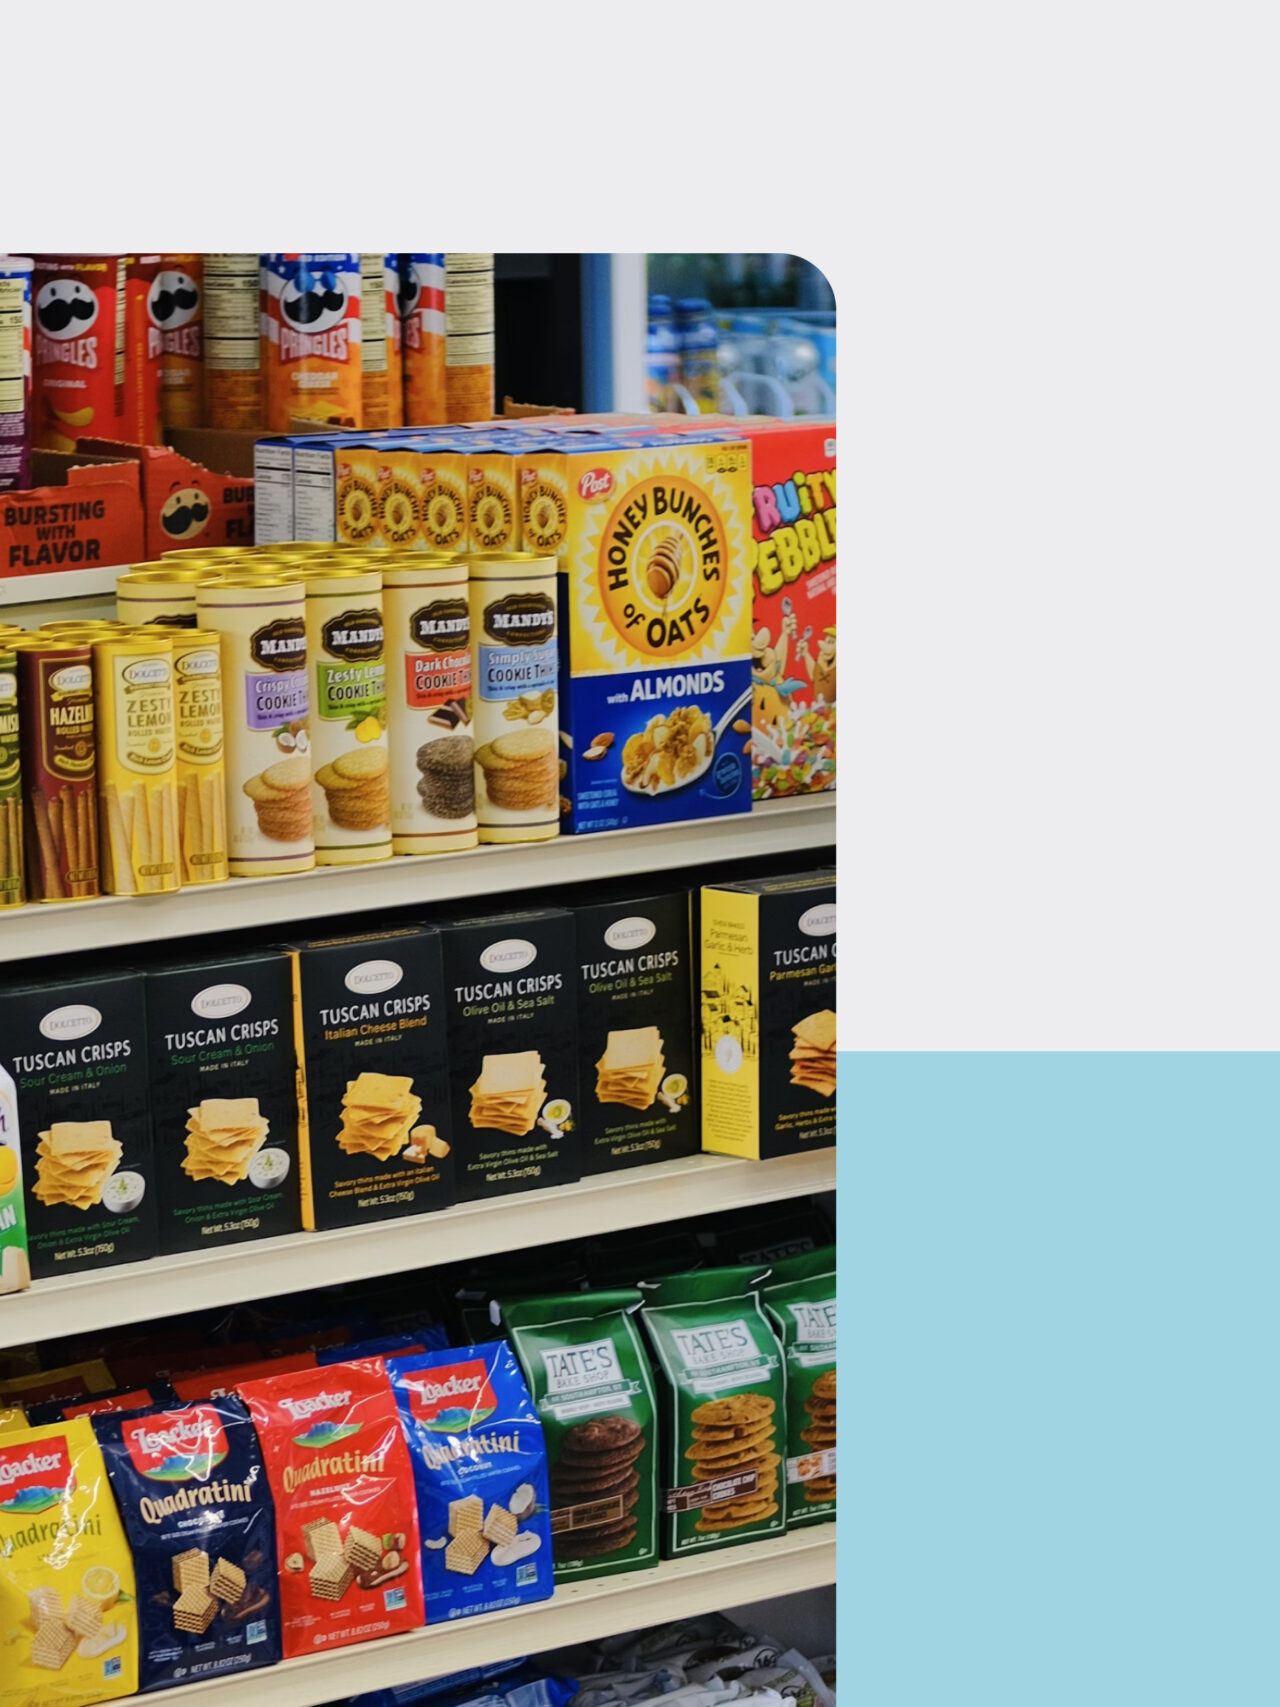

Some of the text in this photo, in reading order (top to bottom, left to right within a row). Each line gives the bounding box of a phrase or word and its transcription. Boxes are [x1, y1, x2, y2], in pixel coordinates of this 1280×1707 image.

[281, 326, 348, 361] PRINGLES
[580, 471, 613, 497] Post
[4, 500, 106, 526] BURSTING
[36, 525, 76, 541] WITH
[608, 486, 720, 591] HONEY BUNCHES
[8, 539, 101, 567] FLAVOR
[623, 597, 710, 649] of OATS
[415, 657, 442, 674] Dark
[489, 651, 531, 667] Simply
[327, 667, 362, 684] Zesty
[416, 672, 457, 690] COOKIE
[487, 666, 532, 683] COOKIE
[607, 670, 725, 705] with ALMONDS
[256, 693, 297, 711] COOKIE
[328, 683, 369, 701] COOKIE
[50, 704, 93, 725] HAZEL
[581, 950, 680, 981] TUSCAN CRISPS
[773, 944, 829, 966] TUSCAN
[588, 971, 673, 995] Olive Oil Sea Salt
[769, 967, 817, 982] Parmesan
[454, 973, 563, 1004] TUSCAN CRISPS
[319, 994, 431, 1026] TUSCAN CRISPS
[462, 1002, 490, 1018] Olive
[491, 1001, 506, 1015] Oil
[516, 997, 536, 1011] Sea
[537, 994, 556, 1007] Salt
[164, 1018, 280, 1051] TUSCAN CRISPS
[324, 1015, 428, 1041] Italian Cheese Blend
[12, 1039, 132, 1074] TUSCAN CRISPS
[171, 1053, 197, 1067] Sour
[198, 1048, 234, 1063] Cream
[245, 1040, 275, 1055] Onion
[19, 1075, 46, 1089] Sour
[48, 1070, 84, 1085] Cream
[96, 1061, 128, 1077] Onion
[793, 1304, 836, 1329] TATE
[677, 1326, 749, 1356] TATE'S
[546, 1346, 613, 1378] TATE'S
[419, 1374, 482, 1406] Loacker
[556, 1370, 610, 1388] BAKE SHOP
[278, 1390, 352, 1422] Loacker
[130, 1418, 214, 1455] Loacker
[282, 1450, 385, 1494] Quadratini
[139, 1479, 252, 1525] Quadratini
